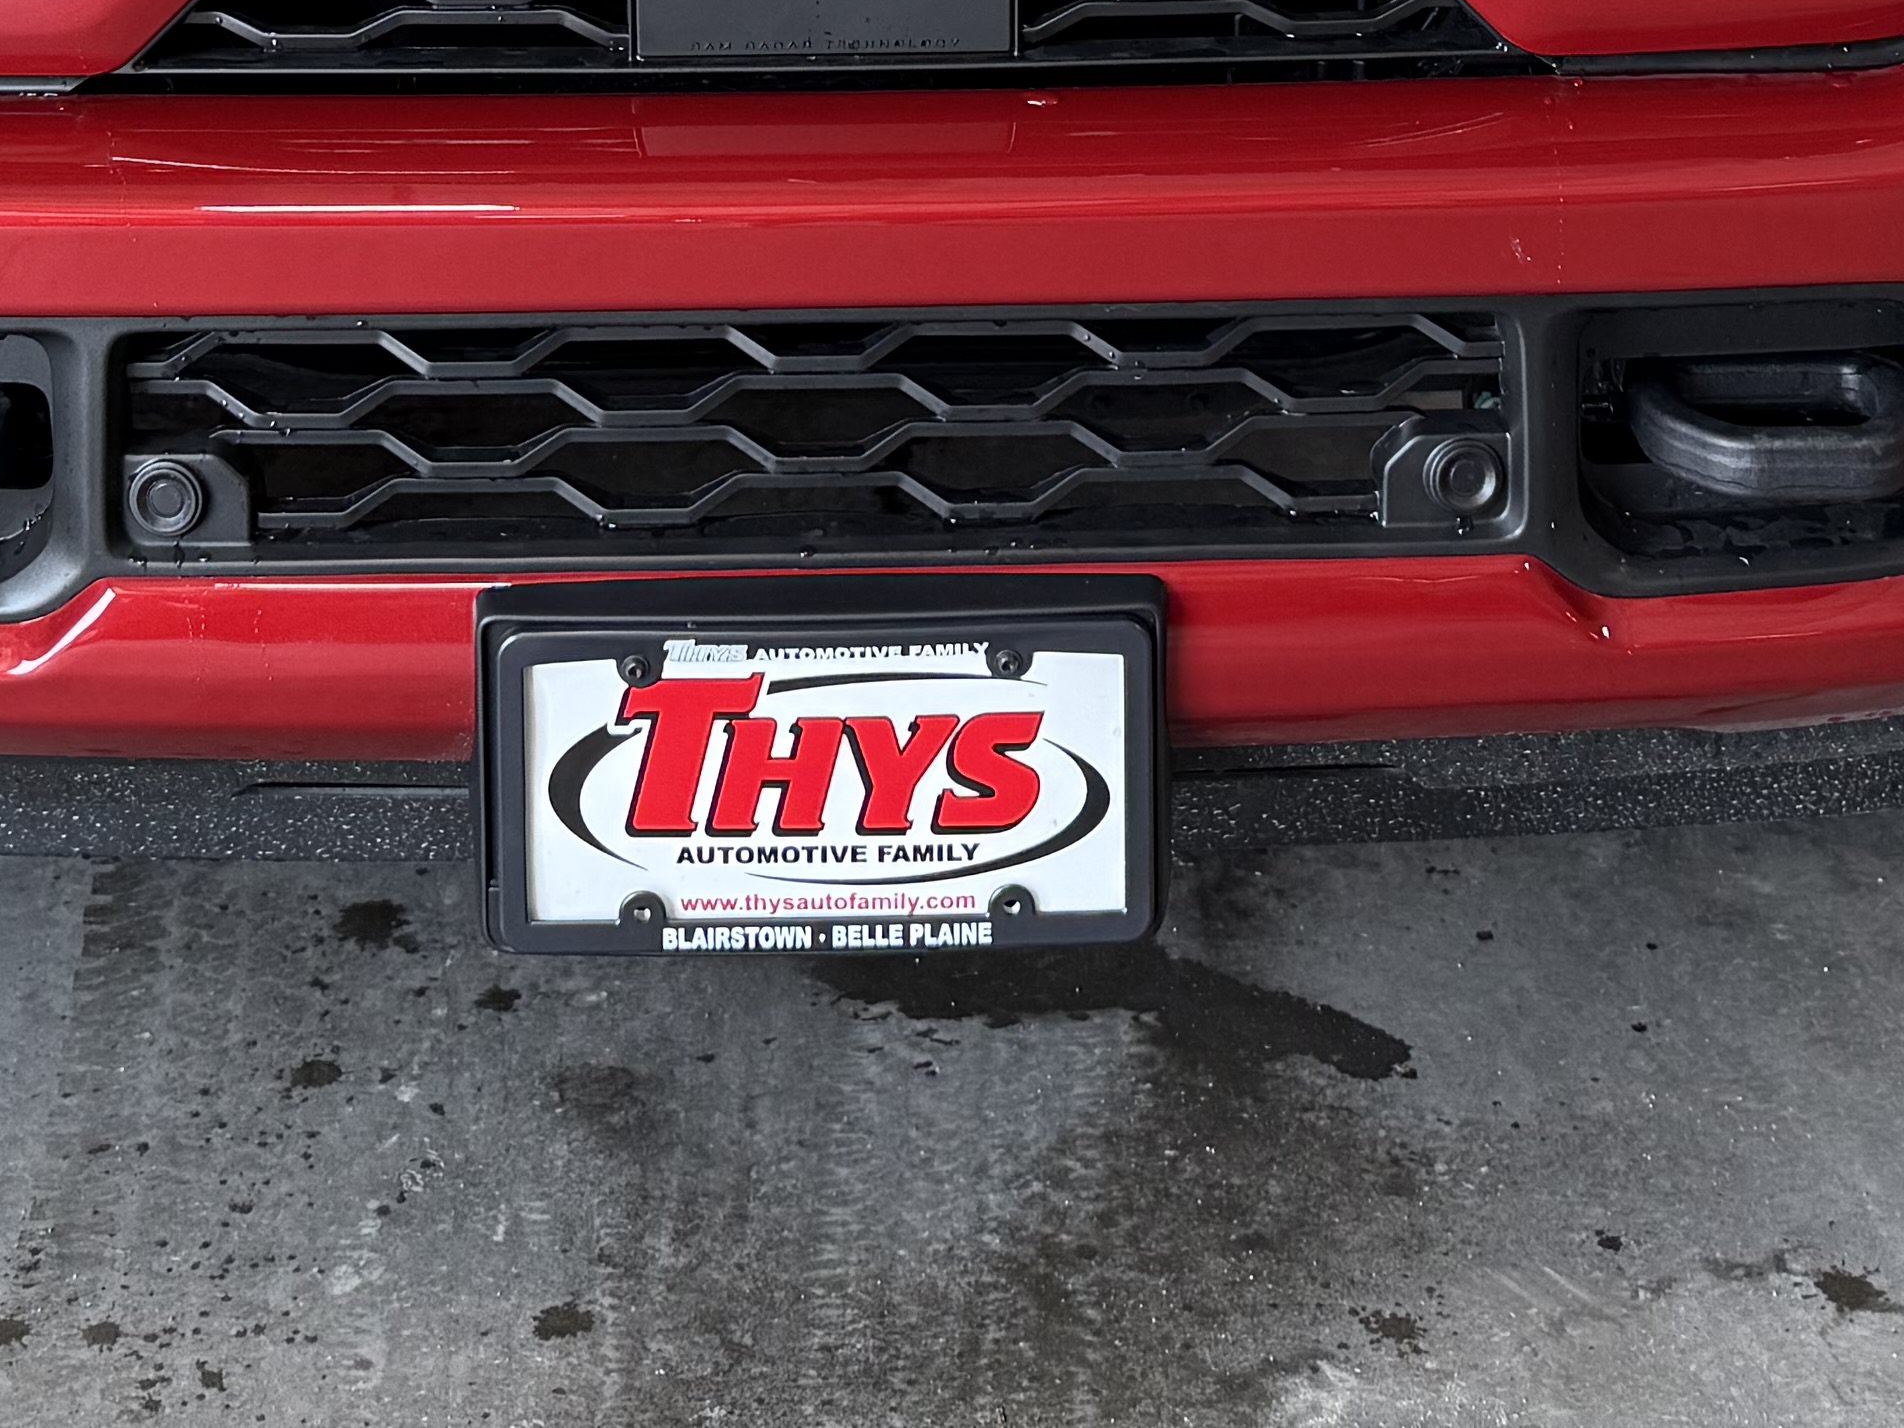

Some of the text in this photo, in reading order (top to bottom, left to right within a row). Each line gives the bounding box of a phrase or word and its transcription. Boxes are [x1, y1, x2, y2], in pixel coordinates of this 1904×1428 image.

[754, 645, 902, 662] AUTOMOTIVE
[909, 641, 989, 658] FAMILY
[615, 673, 1045, 837] THYS
[676, 843, 981, 865] AUTOMOTIVE FAMILY
[680, 892, 976, 916] www.thysautofamily.com
[662, 921, 993, 951] BLAIRSTOWN BELLE PLAINE
